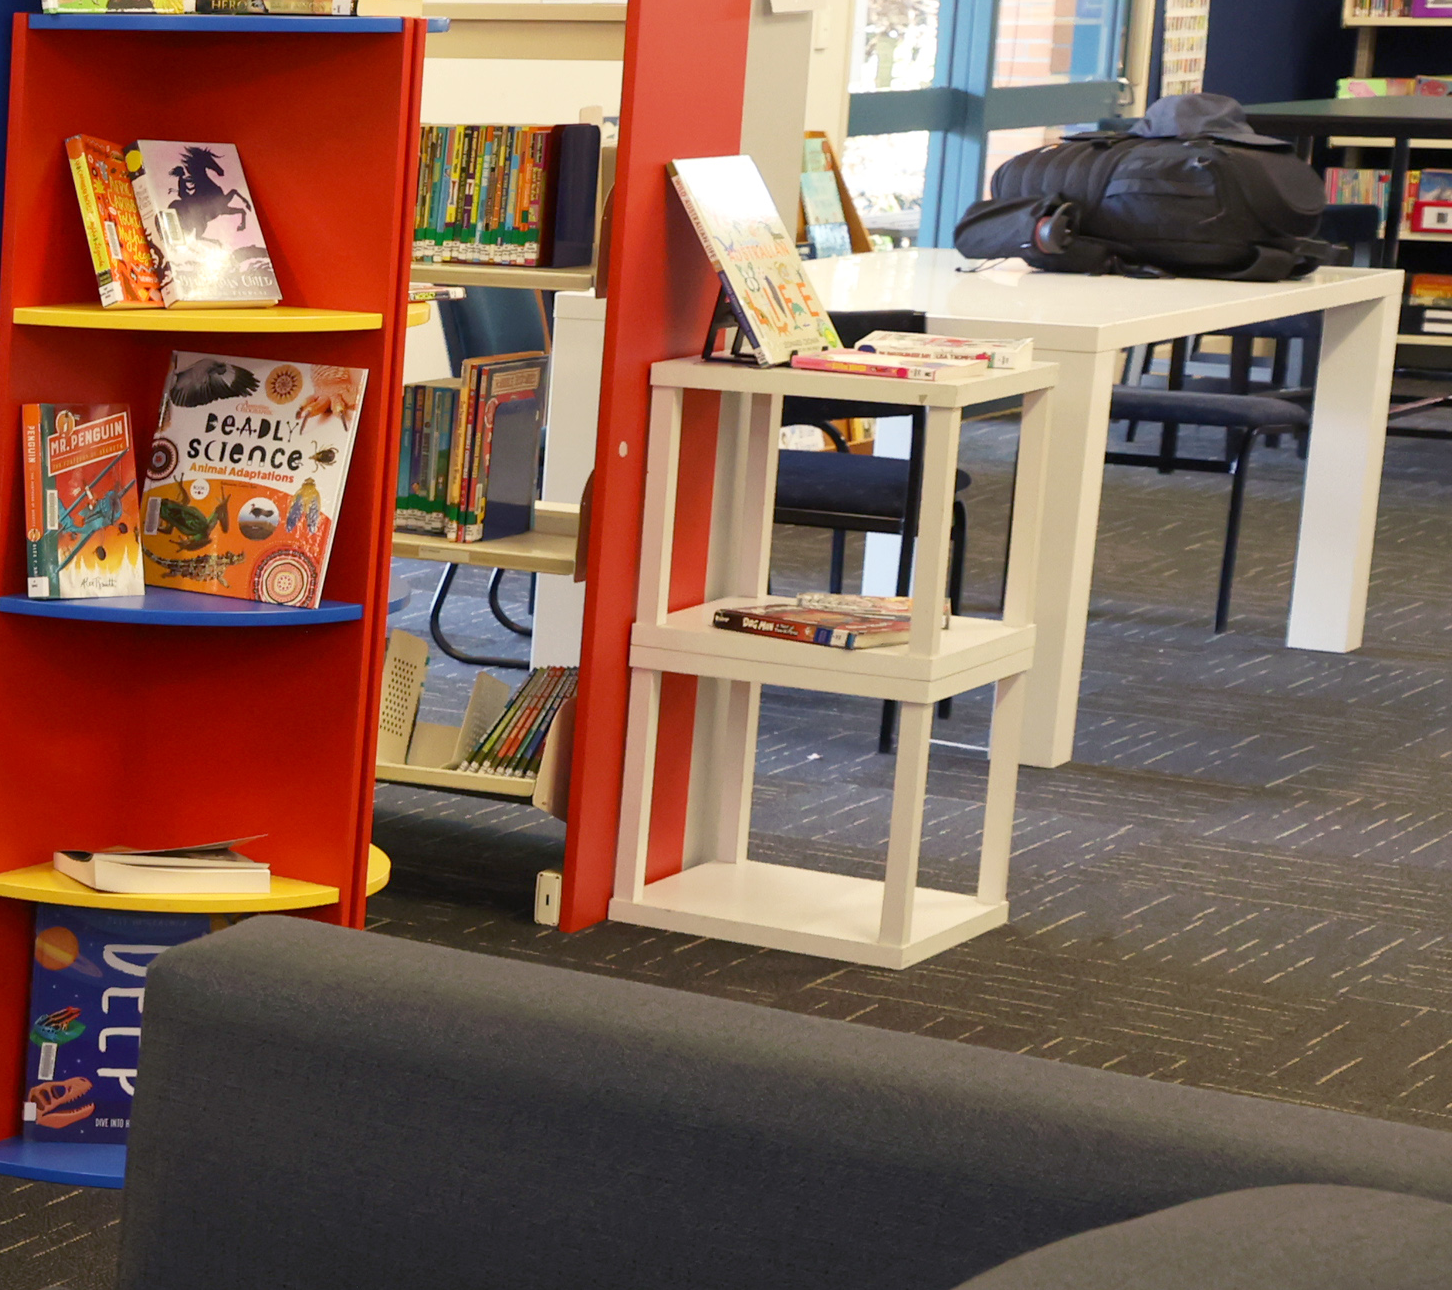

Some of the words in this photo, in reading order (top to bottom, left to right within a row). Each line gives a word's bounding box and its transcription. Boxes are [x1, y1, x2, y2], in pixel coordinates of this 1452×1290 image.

[27, 425, 36, 464] PENGUIN
[71, 420, 123, 449] PENGUIN
[189, 462, 228, 474] Animal
[228, 468, 295, 483] Adaptations
[95, 1118, 108, 1128] DIVE
[110, 1118, 124, 1129] INTO
